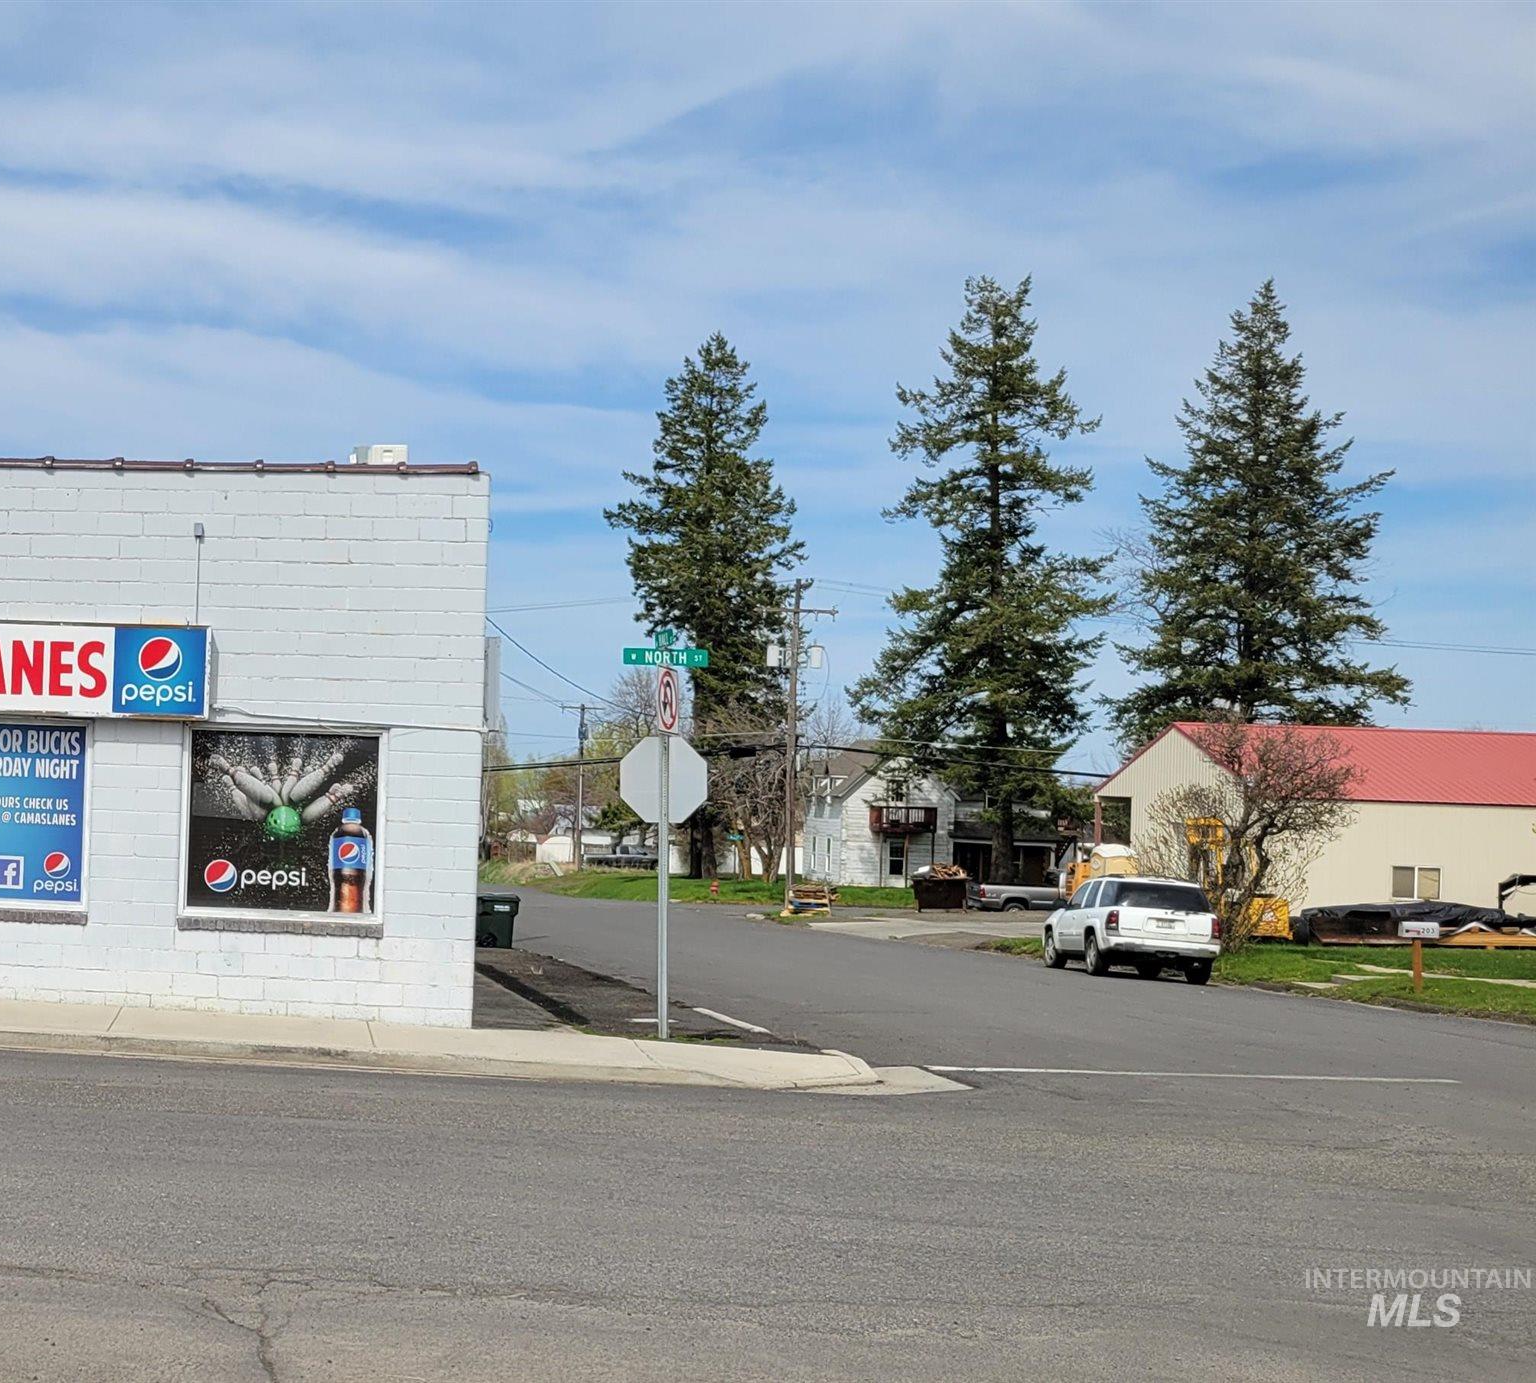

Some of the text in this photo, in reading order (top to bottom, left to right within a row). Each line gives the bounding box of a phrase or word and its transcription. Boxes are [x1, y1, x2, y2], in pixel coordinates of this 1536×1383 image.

[644, 650, 687, 665] NORTH
[121, 680, 197, 706] pepsi
[27, 730, 81, 756] BUCKS
[35, 758, 79, 780] NIGHT
[23, 797, 53, 810] CHECK
[56, 798, 69, 811] US
[2, 811, 12, 824] @
[14, 811, 76, 826] CAMASLANES
[33, 878, 79, 894] pepsi
[240, 867, 309, 890] pepsi
